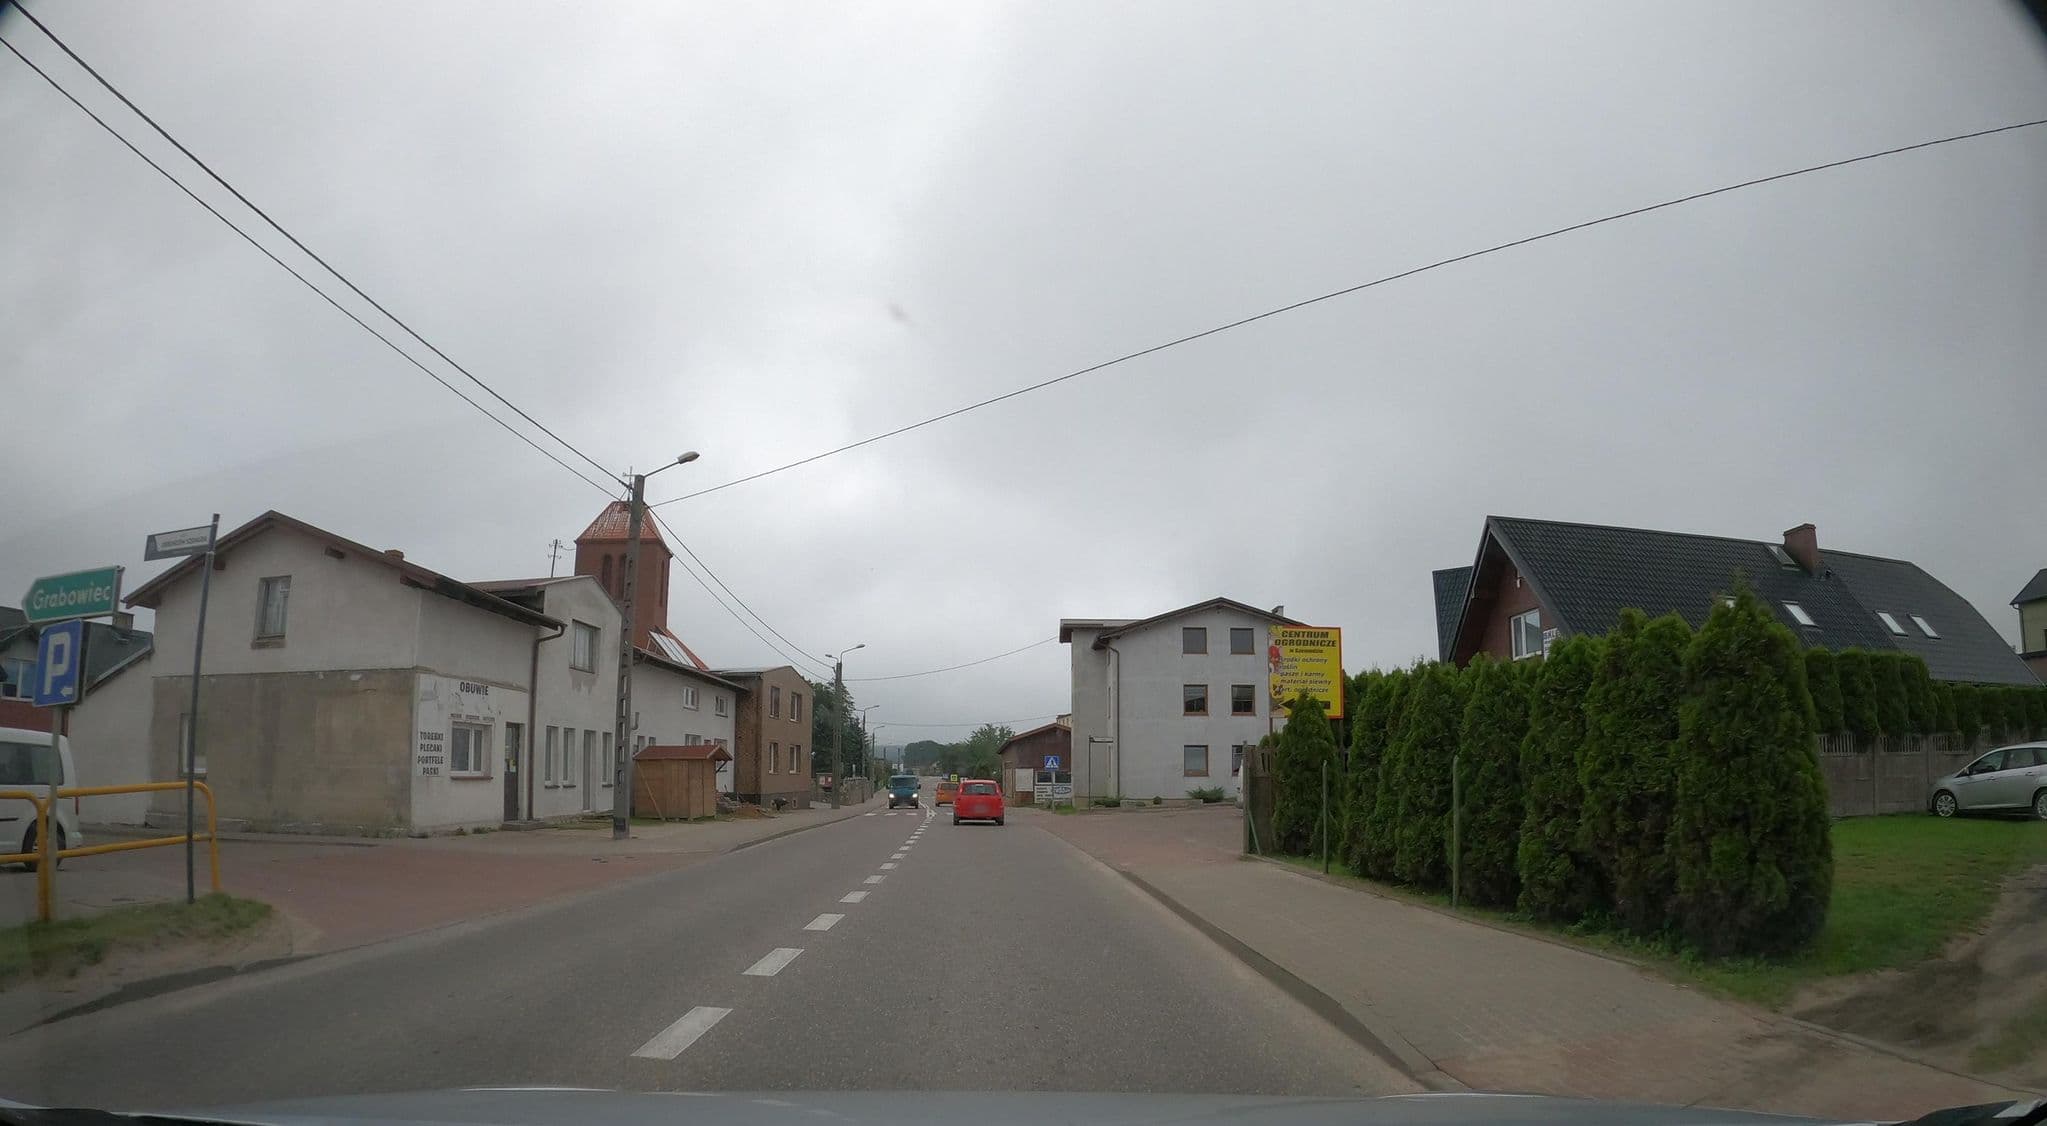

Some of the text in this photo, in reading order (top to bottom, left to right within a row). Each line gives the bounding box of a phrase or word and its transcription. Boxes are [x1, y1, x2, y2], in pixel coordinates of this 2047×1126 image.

[32, 582, 112, 610] Grabowiec
[1275, 639, 1336, 647] OGRODNICZE
[44, 631, 72, 695] P
[459, 681, 489, 696] OBUWIE
[419, 731, 444, 740] TOREBKI
[419, 744, 443, 752] PLECAKI
[417, 755, 444, 765] PORTFELE
[422, 767, 439, 776] PASKI
